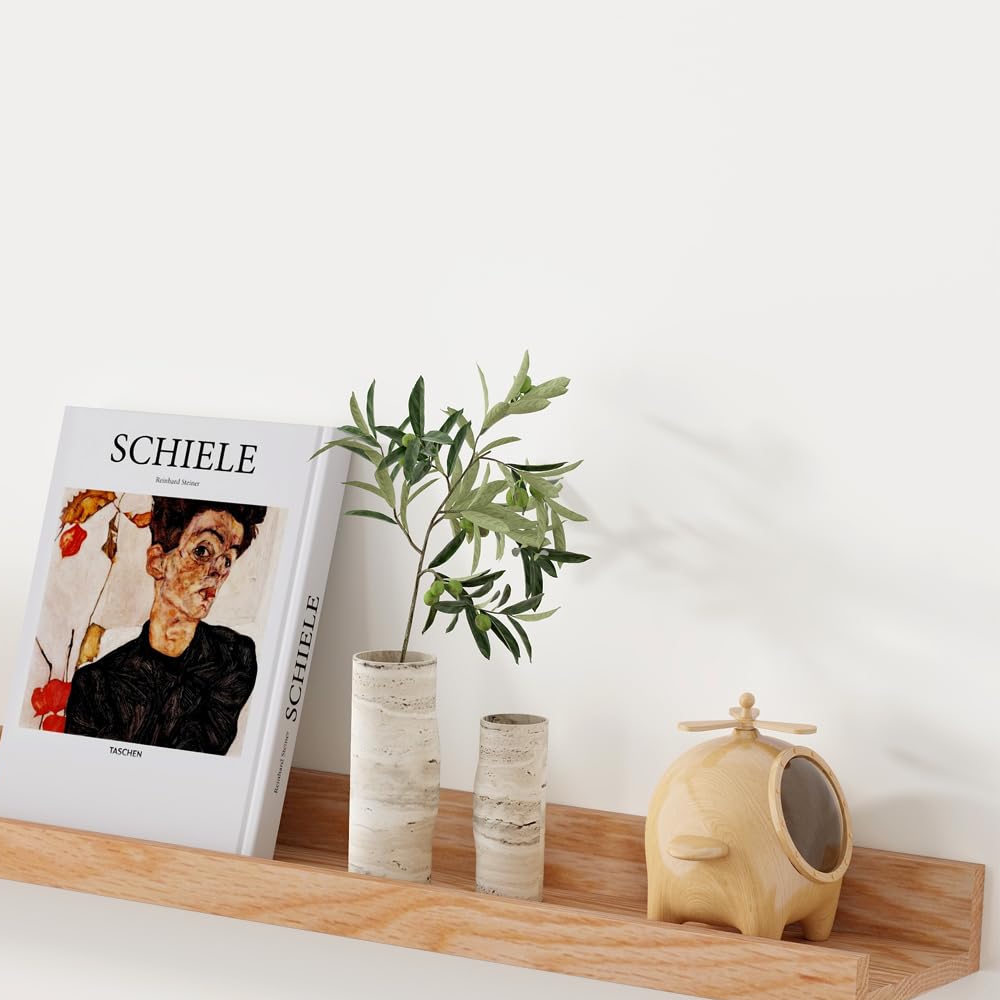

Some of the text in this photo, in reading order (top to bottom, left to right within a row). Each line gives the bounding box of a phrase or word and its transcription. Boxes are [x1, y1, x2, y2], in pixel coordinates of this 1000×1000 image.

[110, 433, 258, 475] SCHIELE
[155, 476, 201, 488] Reinhard Steiner
[285, 594, 321, 723] SCHIELE
[109, 746, 143, 759] TASCHEN
